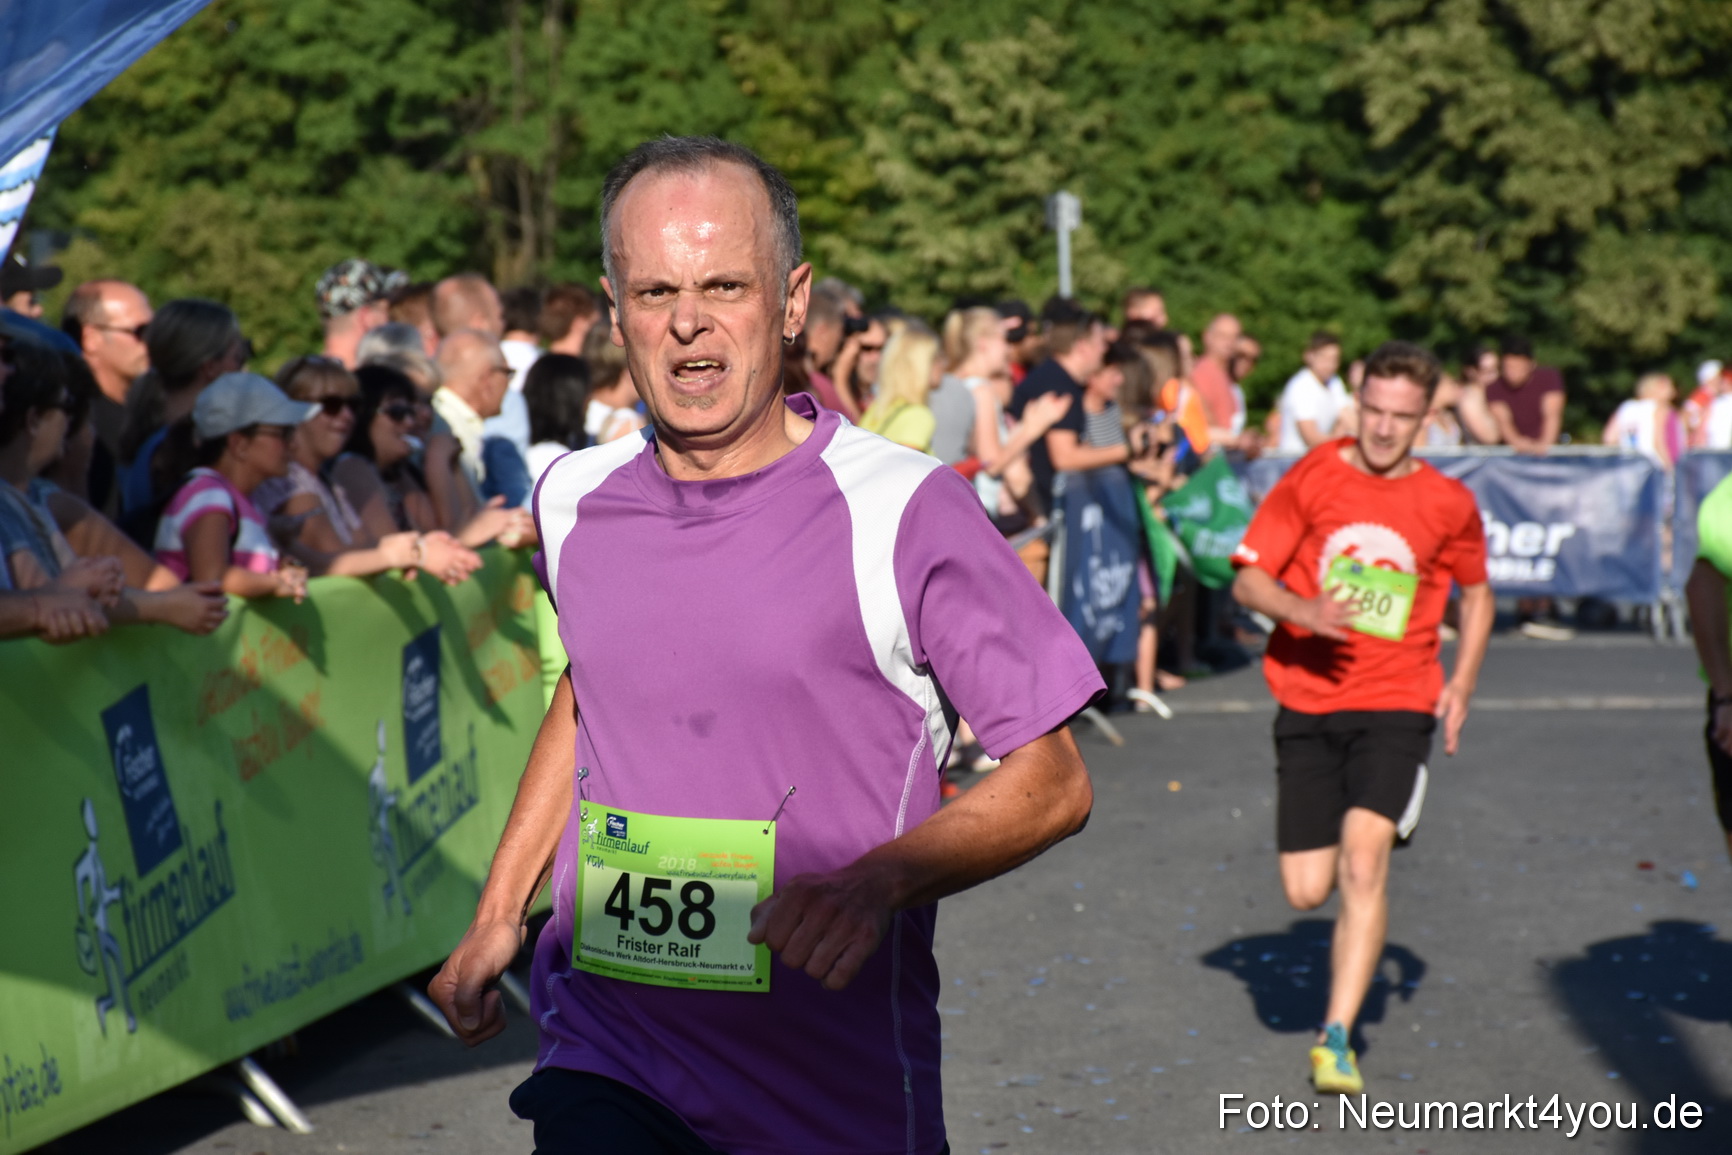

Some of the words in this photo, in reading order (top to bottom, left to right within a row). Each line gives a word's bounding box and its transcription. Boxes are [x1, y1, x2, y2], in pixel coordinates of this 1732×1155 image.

[1482, 510, 1576, 557] her
[597, 831, 651, 855] firmenlauf
[658, 855, 697, 871] 2018
[604, 872, 716, 940] 458
[580, 942, 615, 958] Diakonisches
[616, 951, 632, 961] Werk
[633, 954, 738, 971] Altdorf-Hersbruck-Neumarkt
[739, 963, 755, 971] e.V.
[617, 934, 663, 955] Frister
[667, 942, 702, 958] Ralf
